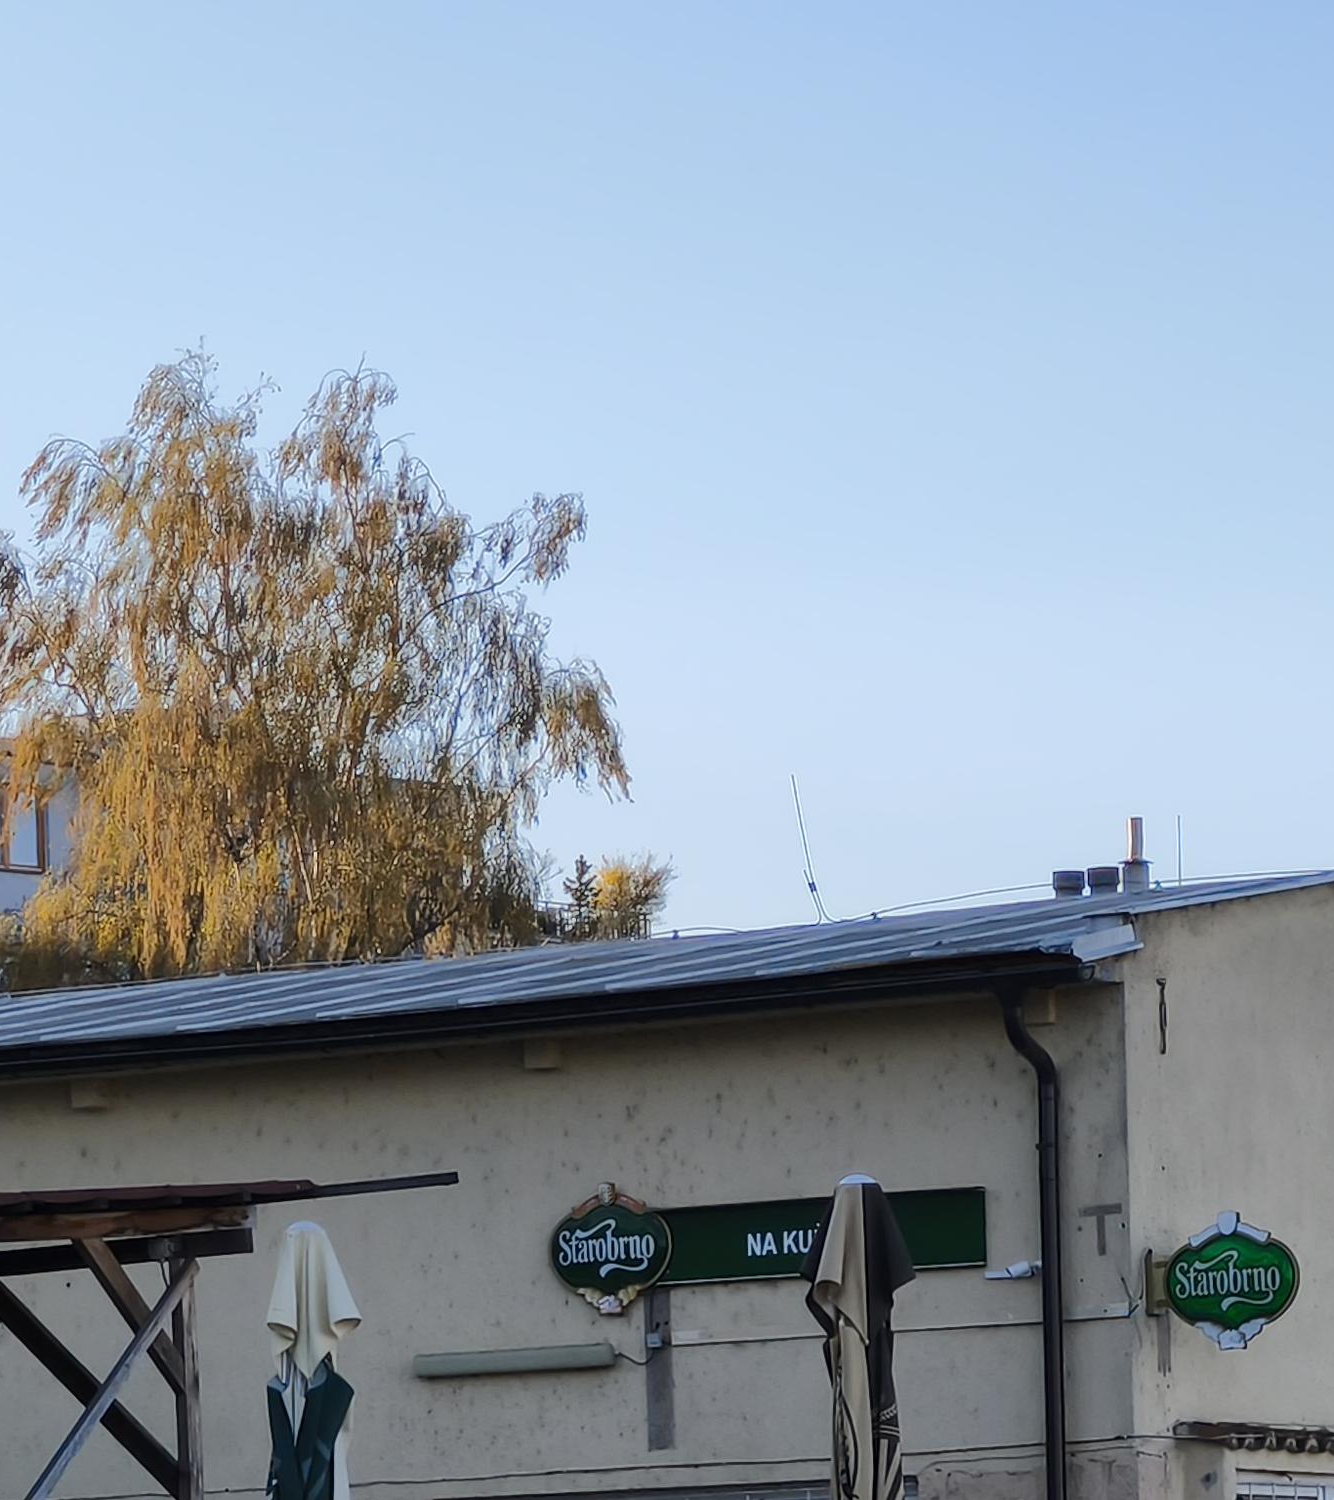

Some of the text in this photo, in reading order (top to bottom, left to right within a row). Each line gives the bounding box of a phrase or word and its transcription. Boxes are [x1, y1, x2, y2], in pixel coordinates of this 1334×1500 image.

[558, 1218, 655, 1279] Starobrno
[747, 1224, 818, 1257] NA KU
[1175, 1250, 1280, 1311] Starobrno
